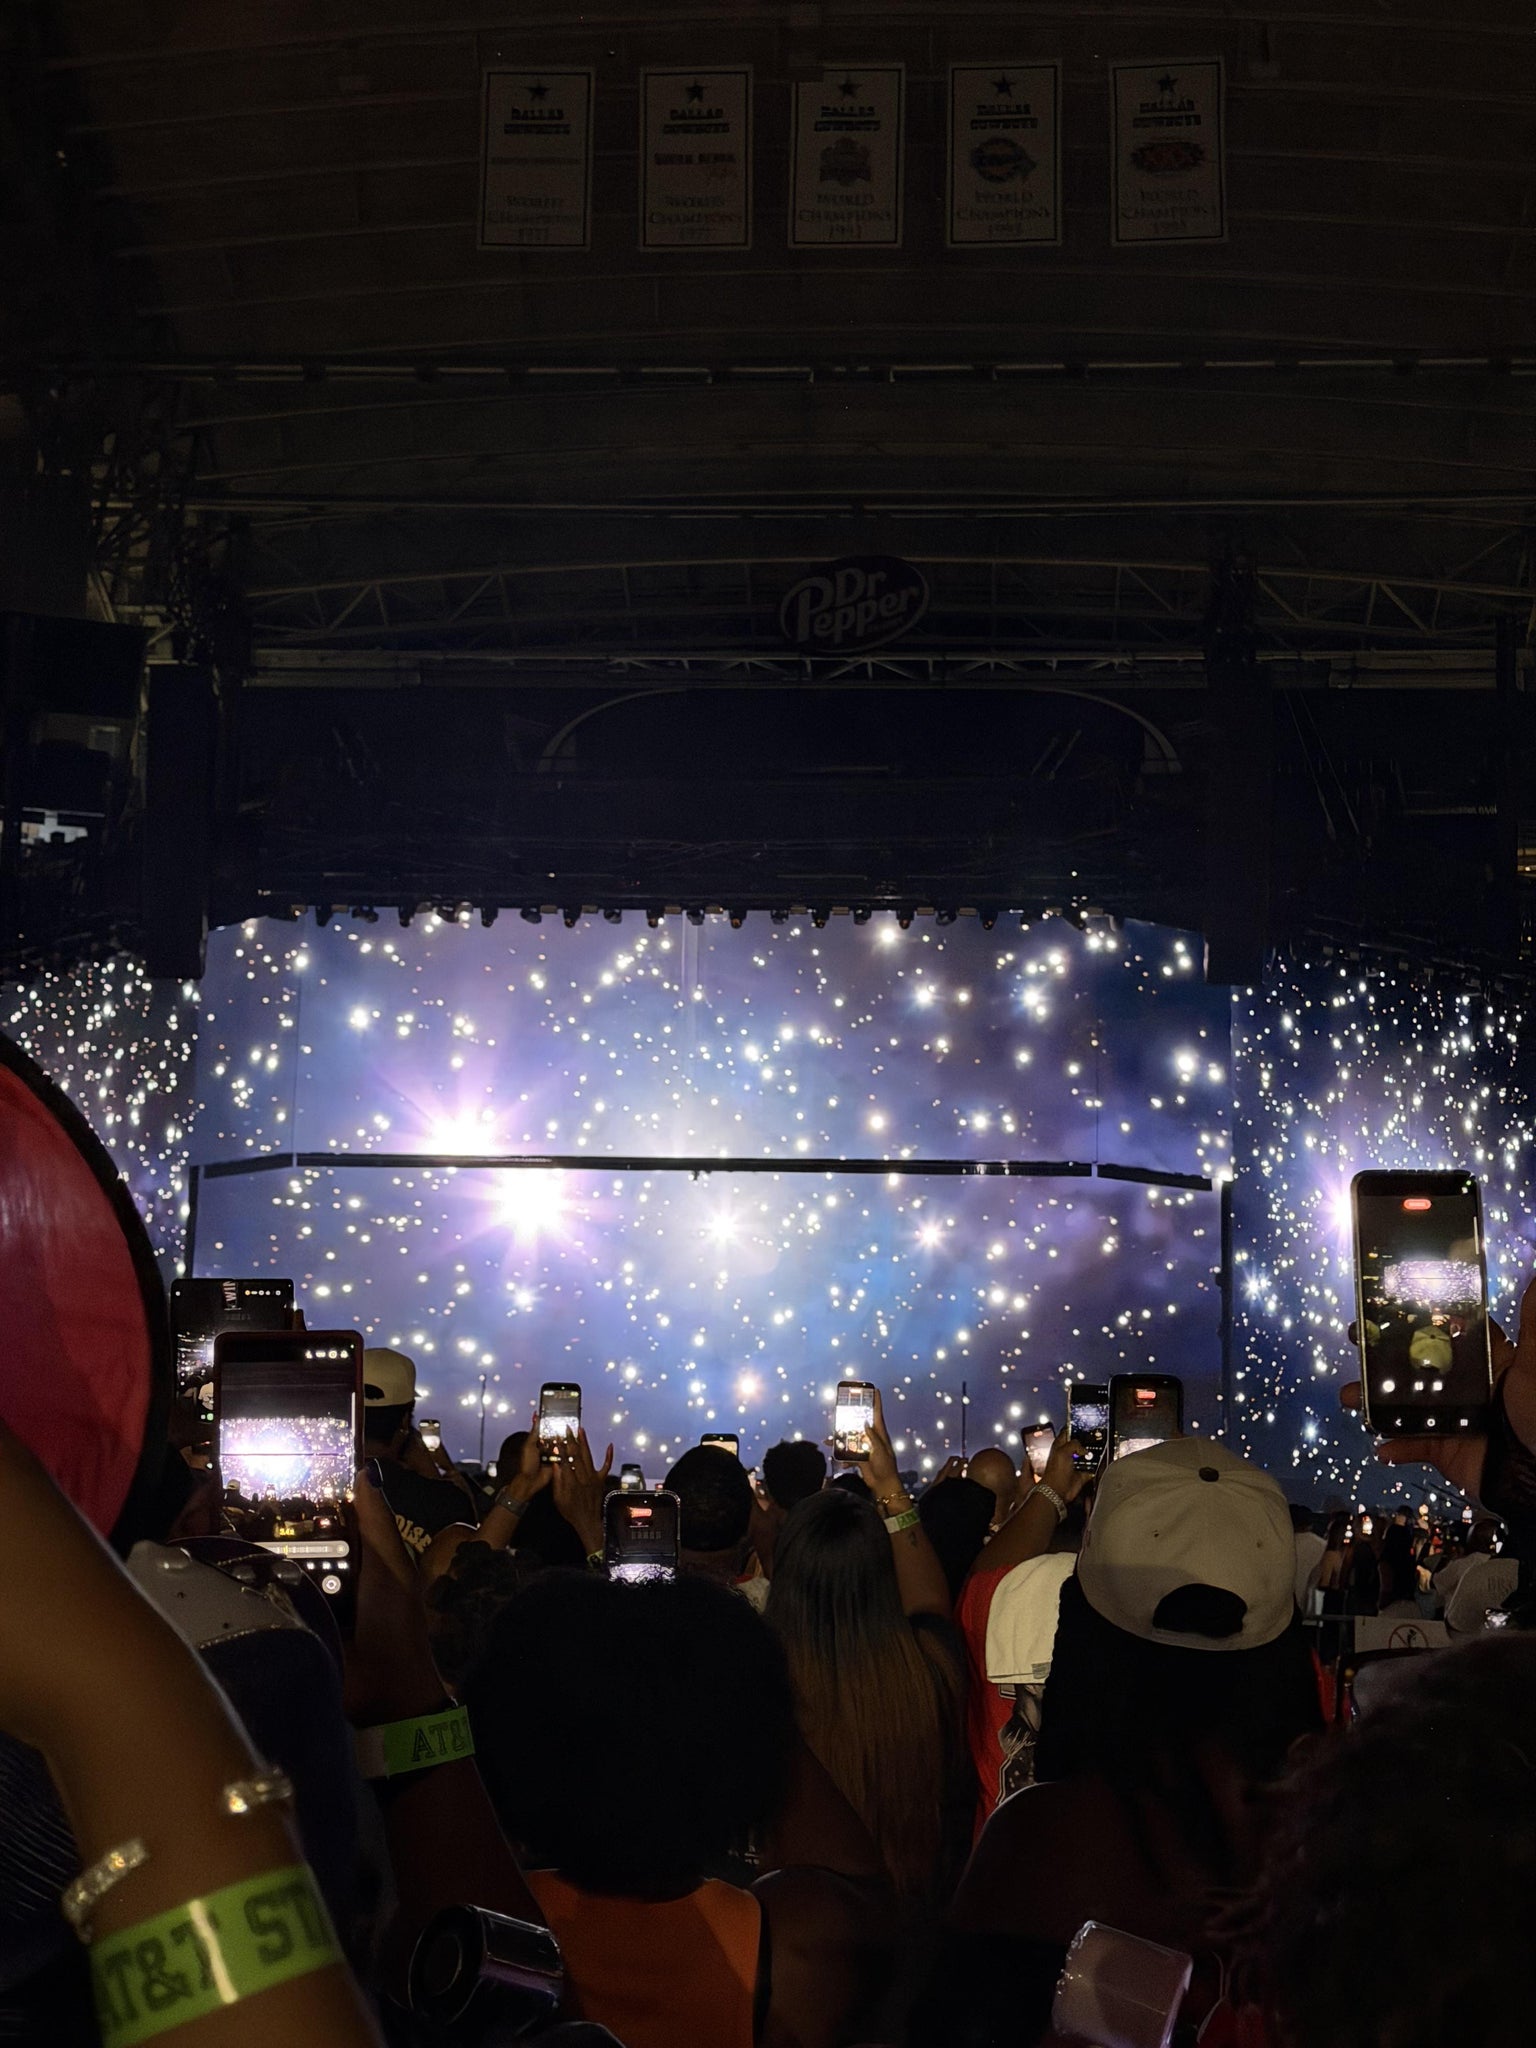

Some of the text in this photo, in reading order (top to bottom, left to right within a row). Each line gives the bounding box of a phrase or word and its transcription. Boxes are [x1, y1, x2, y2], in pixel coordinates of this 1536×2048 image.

[784, 576, 919, 643] Pepper
[835, 567, 887, 607] Dr
[97, 1908, 222, 2034] T&T
